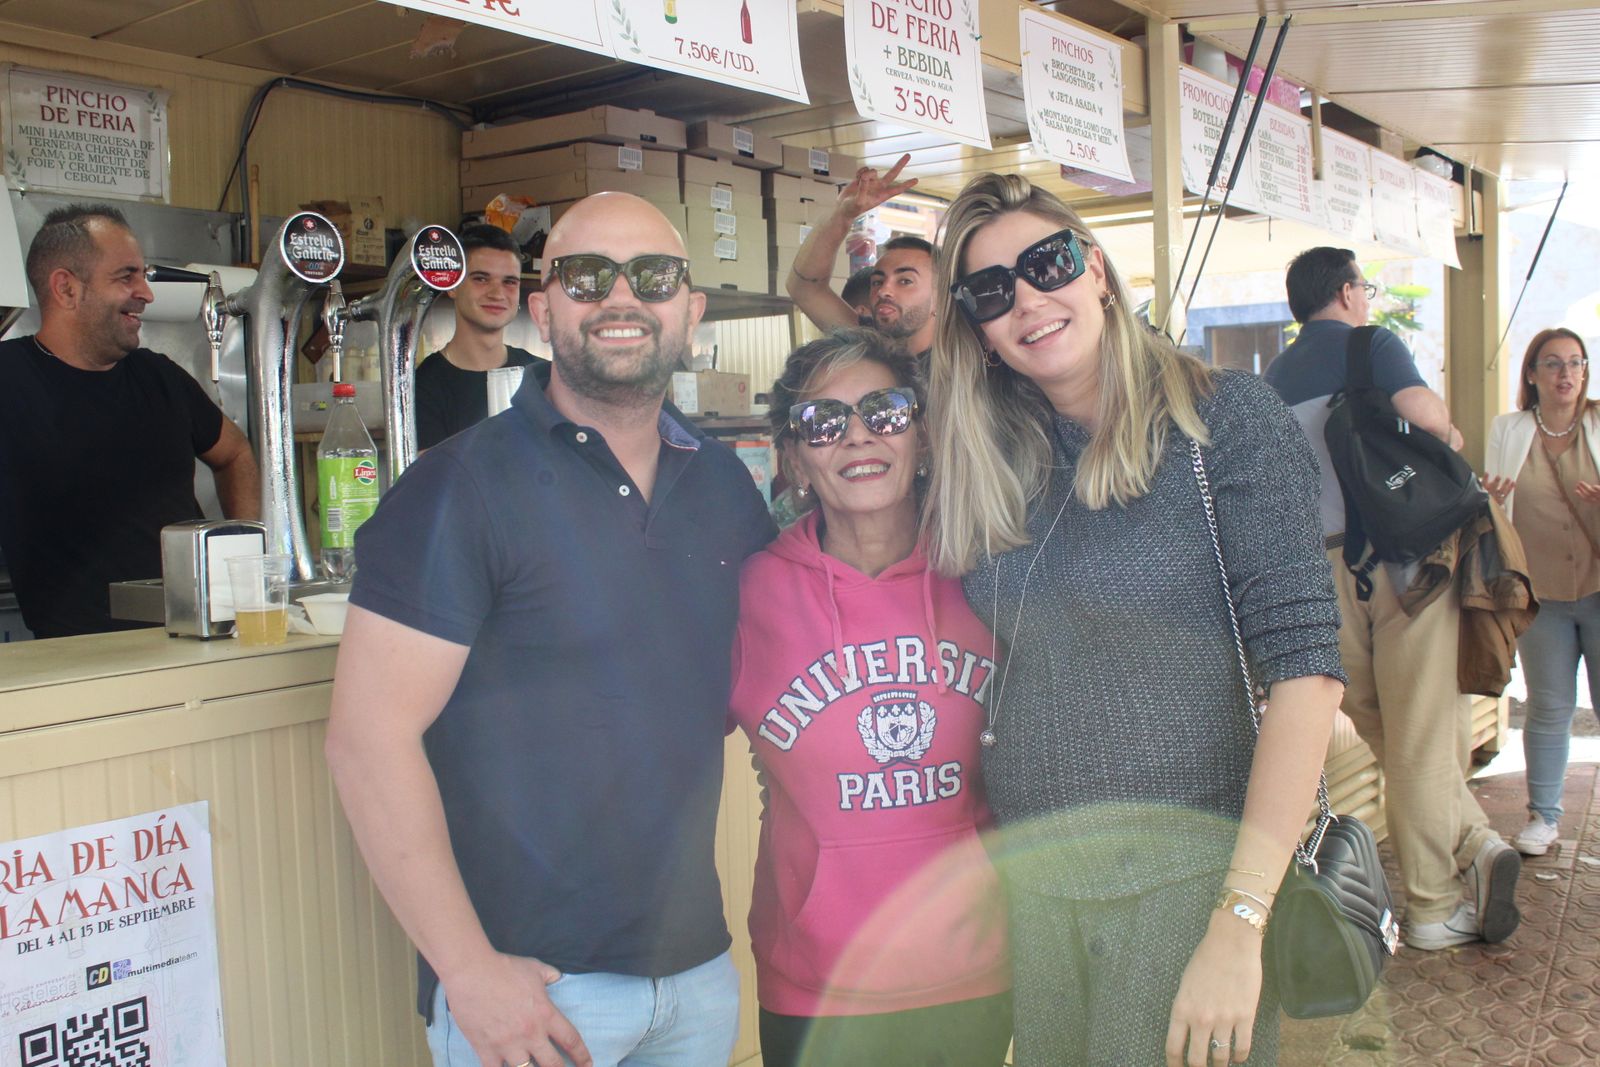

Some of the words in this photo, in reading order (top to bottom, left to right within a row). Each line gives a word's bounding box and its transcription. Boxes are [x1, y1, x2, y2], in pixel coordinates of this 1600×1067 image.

[871, 1, 899, 35] DE
[906, 14, 961, 55] FERIA
[674, 37, 759, 74] 7,50€/UD.
[1052, 36, 1094, 64] PINCHOS
[897, 46, 953, 81] BEBIDA
[1051, 58, 1086, 79] BROCHETA
[1087, 71, 1096, 82] DE
[1051, 69, 1095, 92] LANGOSTINOS
[46, 85, 127, 112] PINCHO
[1056, 91, 1073, 106] JETA
[1075, 98, 1097, 113] ASADA
[40, 104, 69, 124] DE
[77, 110, 135, 133] FERIA
[1043, 108, 1073, 125] MONTADO
[1074, 118, 1082, 127] DE
[1083, 120, 1099, 133] LOMO
[1045, 118, 1064, 131] SALSA
[1065, 124, 1092, 140] MOSTAZA
[1193, 108, 1224, 129] BOTELLA
[18, 124, 45, 137] MINI
[49, 127, 137, 149] HAMBURGUESA
[139, 140, 155, 151] DE
[1204, 126, 1221, 141] SIDR
[26, 136, 82, 152] TERNERA
[85, 143, 130, 157] CHARRA
[134, 150, 148, 160] EN
[31, 147, 66, 160] CAMA
[68, 152, 85, 162] DE
[88, 154, 127, 167] MICUIT
[130, 159, 146, 169] DE
[1066, 139, 1099, 162] 2,50€
[27, 157, 55, 169] FOIE
[58, 160, 66, 169] Y
[68, 162, 132, 177] CRUJIENTE
[134, 169, 150, 180] DE
[64, 171, 117, 186] CEBOLLA
[290, 233, 334, 247] Estrella
[419, 244, 457, 257] Estrella
[292, 246, 333, 260] Galicia
[421, 257, 458, 270] Galicia
[838, 760, 962, 811] PARIS
[71, 835, 118, 876] DE
[132, 814, 191, 863] DÍA
[0, 862, 195, 940] LAMANCA
[17, 937, 43, 955] DEL
[47, 934, 54, 947] 4
[59, 928, 77, 944] AL
[81, 924, 93, 939] 15
[98, 918, 115, 933] DE
[88, 967, 109, 986] CD
